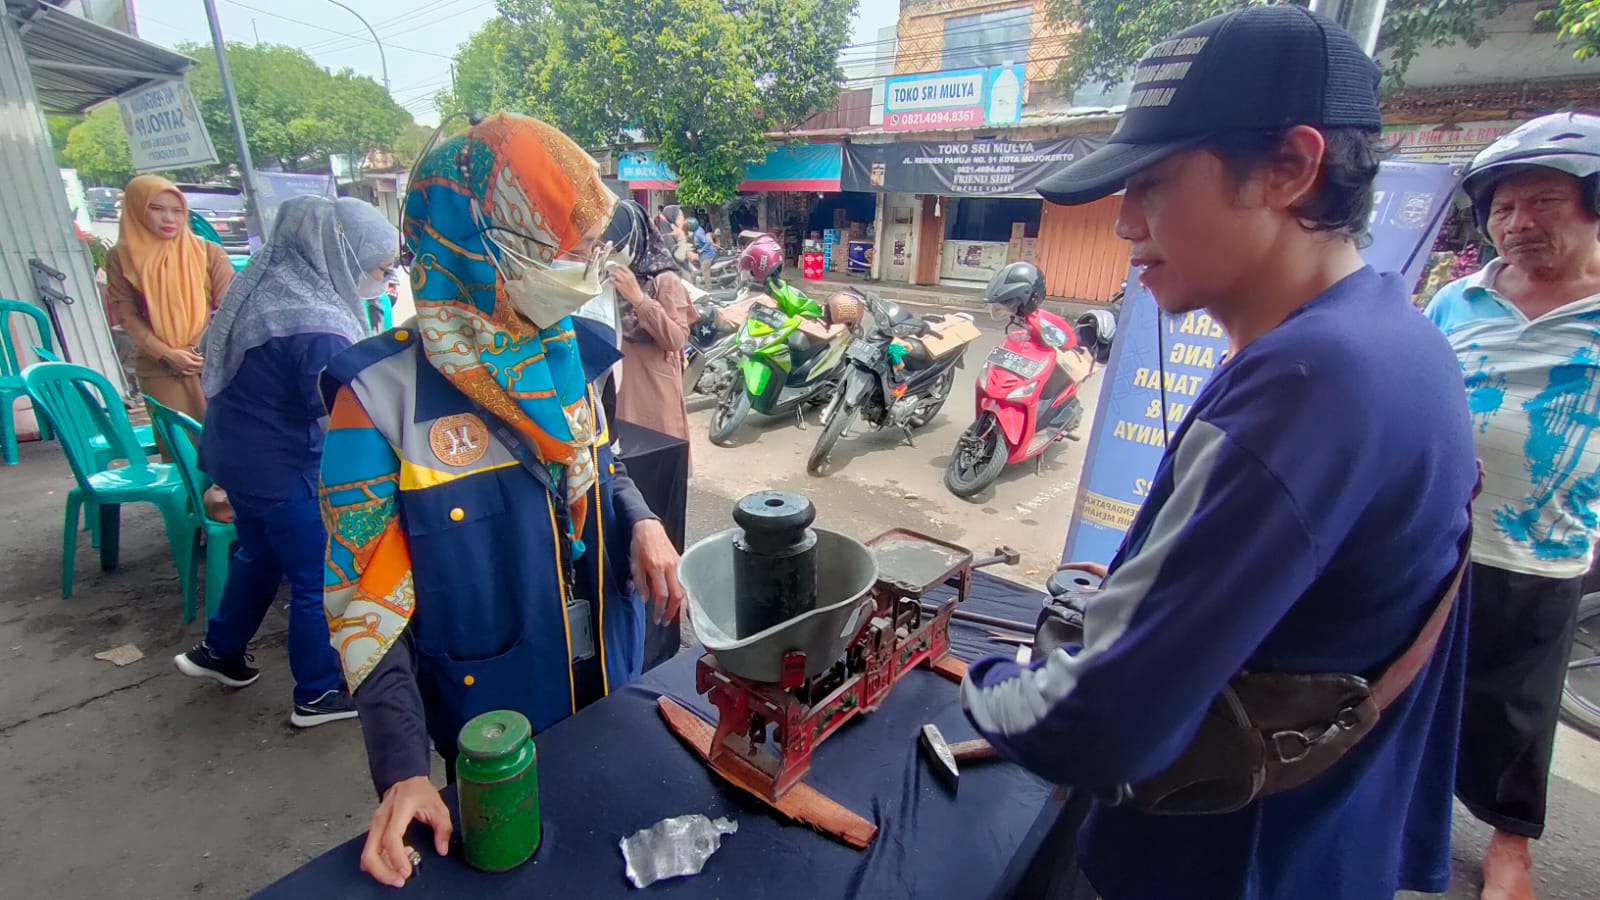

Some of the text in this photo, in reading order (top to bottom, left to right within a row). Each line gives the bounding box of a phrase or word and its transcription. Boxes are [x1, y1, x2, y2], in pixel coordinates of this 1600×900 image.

[895, 82, 974, 102] TOKO SRI MULYA
[902, 110, 974, 125] 0821.4094.8361
[938, 142, 1034, 155] TOKO SRI MULYA
[999, 155, 1020, 163] KOTA
[1021, 153, 1074, 163] MOJOKERTO
[953, 174, 1015, 184] FRIEND SHIP
